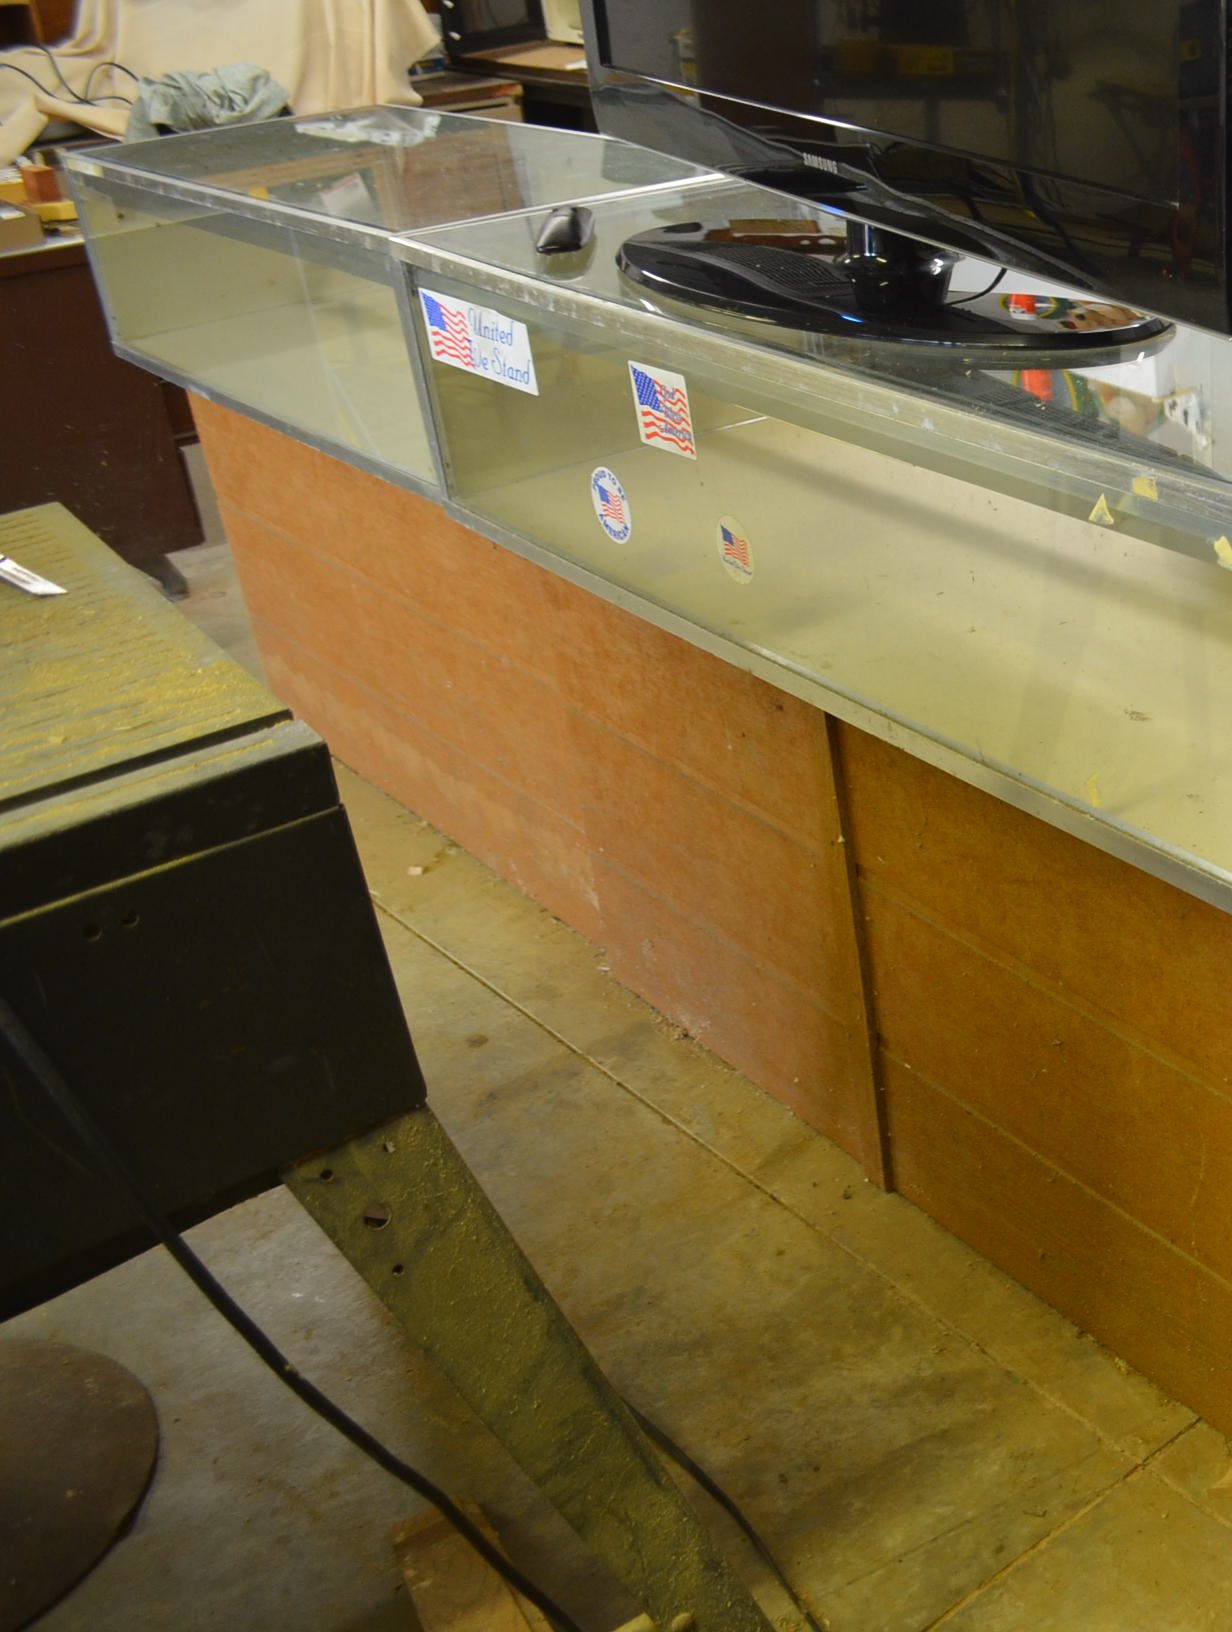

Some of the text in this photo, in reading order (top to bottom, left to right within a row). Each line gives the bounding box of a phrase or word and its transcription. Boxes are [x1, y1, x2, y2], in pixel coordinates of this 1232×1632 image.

[802, 152, 838, 175] SAMSUNG
[467, 307, 514, 346] United
[491, 346, 531, 385] Stand
